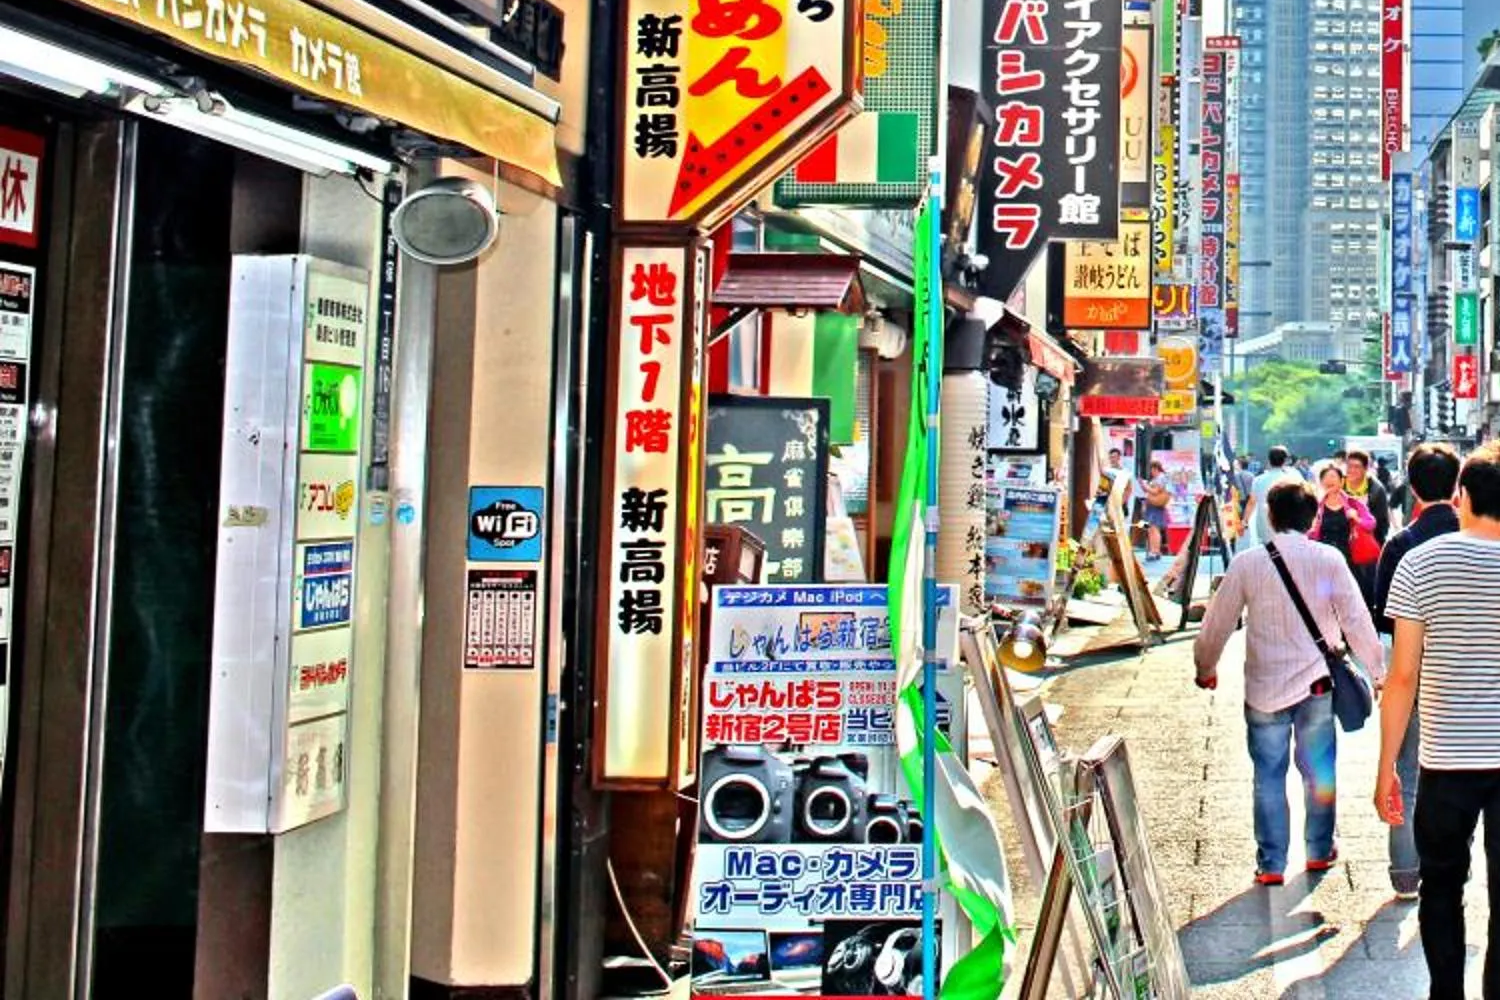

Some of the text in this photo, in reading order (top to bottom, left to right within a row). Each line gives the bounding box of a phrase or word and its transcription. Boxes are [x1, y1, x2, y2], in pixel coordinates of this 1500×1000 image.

[290, 24, 362, 97] カメラ館
[635, 13, 682, 160] 新高揚
[624, 263, 676, 454] 地下1階
[496, 502, 517, 510] Free
[494, 538, 515, 547] Spot
[619, 487, 669, 637] 新高揚
[725, 591, 787, 605] デジカメ
[793, 590, 824, 604] Mac
[830, 590, 863, 604] iPod
[709, 680, 842, 709] じゃんぱら
[706, 713, 841, 745] 新宿2号店
